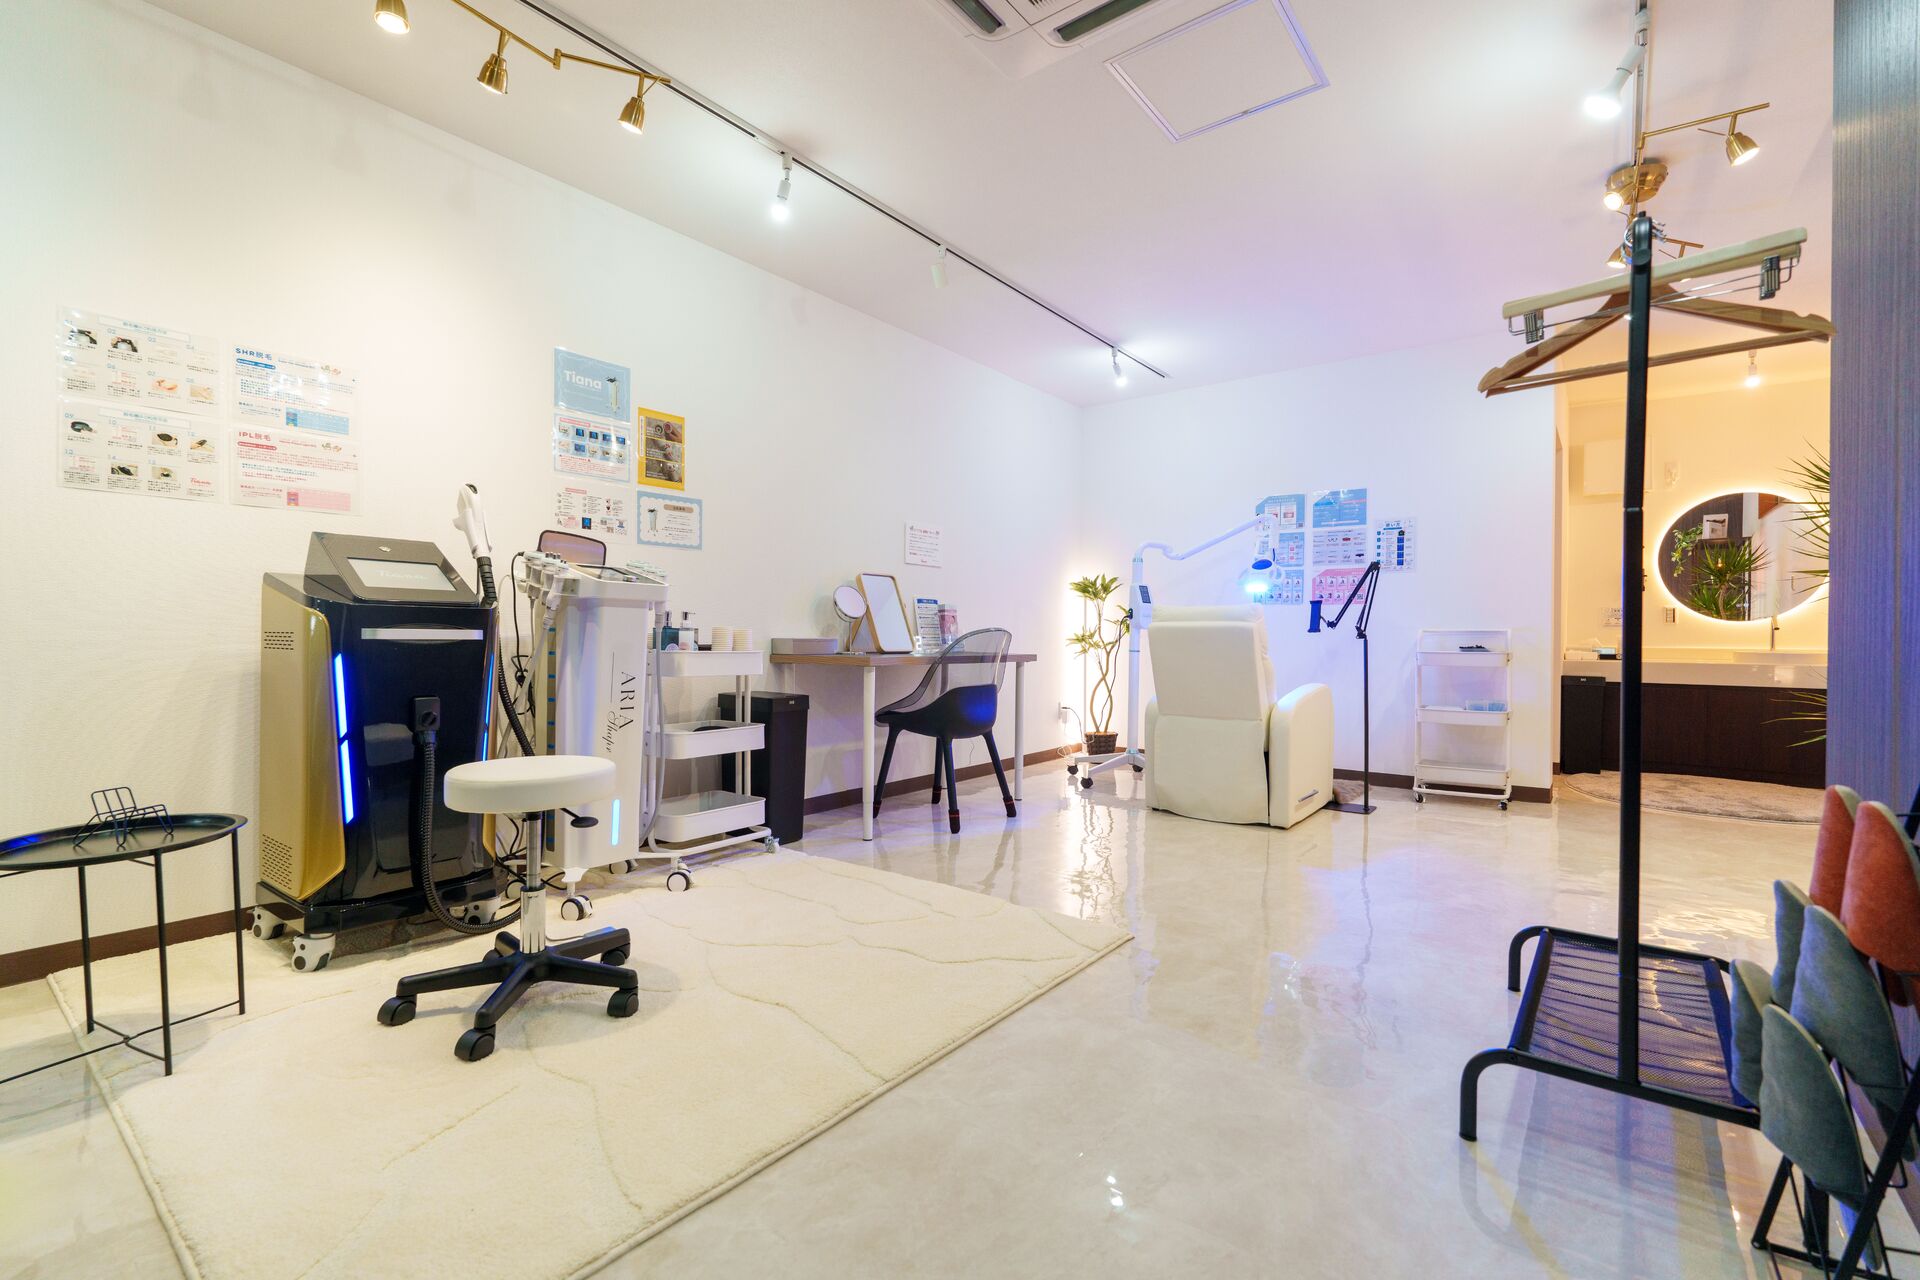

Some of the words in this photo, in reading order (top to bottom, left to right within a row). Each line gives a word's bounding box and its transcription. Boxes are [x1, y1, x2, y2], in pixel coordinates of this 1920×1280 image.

[235, 347, 272, 360] SHR脱毛
[563, 369, 602, 389] Tiana
[239, 431, 271, 441] IPL脱毛
[619, 671, 636, 729] ARIA
[602, 710, 618, 753] Shape
